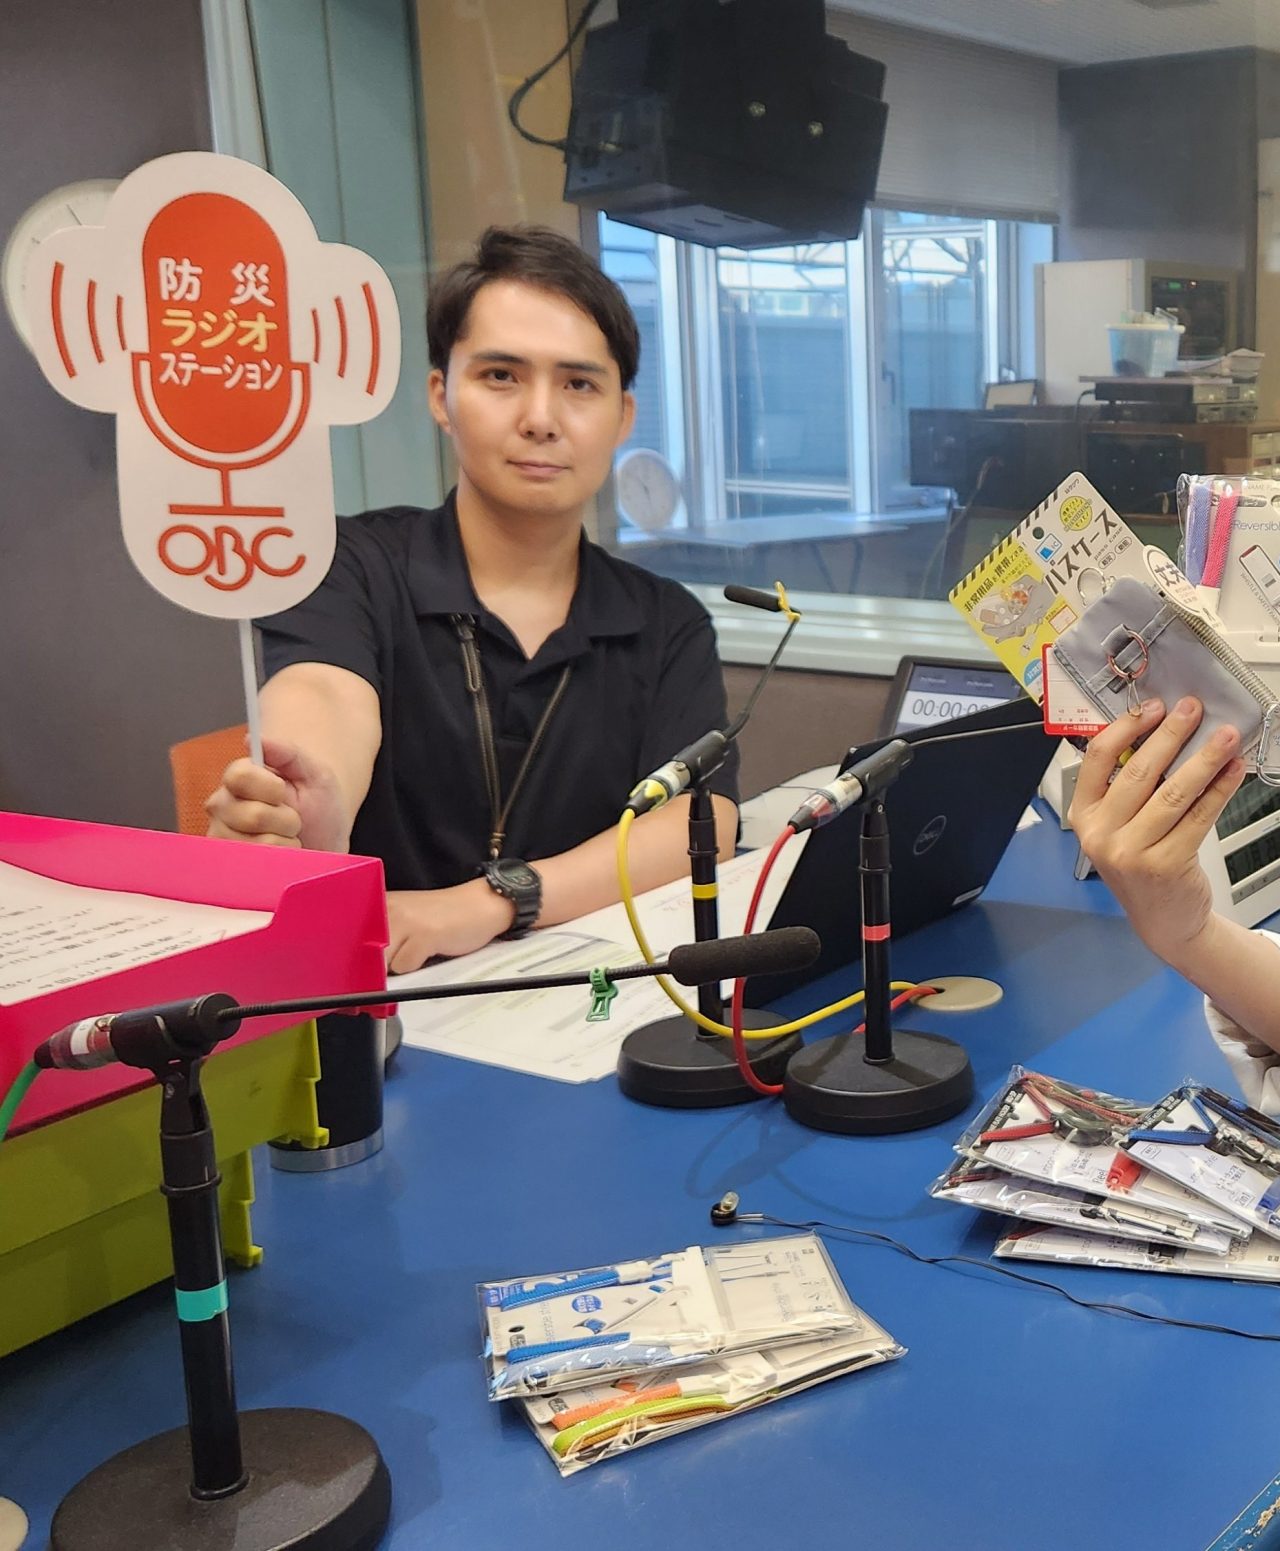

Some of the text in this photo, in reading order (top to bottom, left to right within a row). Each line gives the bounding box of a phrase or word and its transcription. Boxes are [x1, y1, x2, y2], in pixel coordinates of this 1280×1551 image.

[161, 309, 278, 353] ラジオ
[158, 352, 284, 391] ステーション
[158, 524, 307, 592] OBC
[1044, 508, 1118, 595] パスケース
